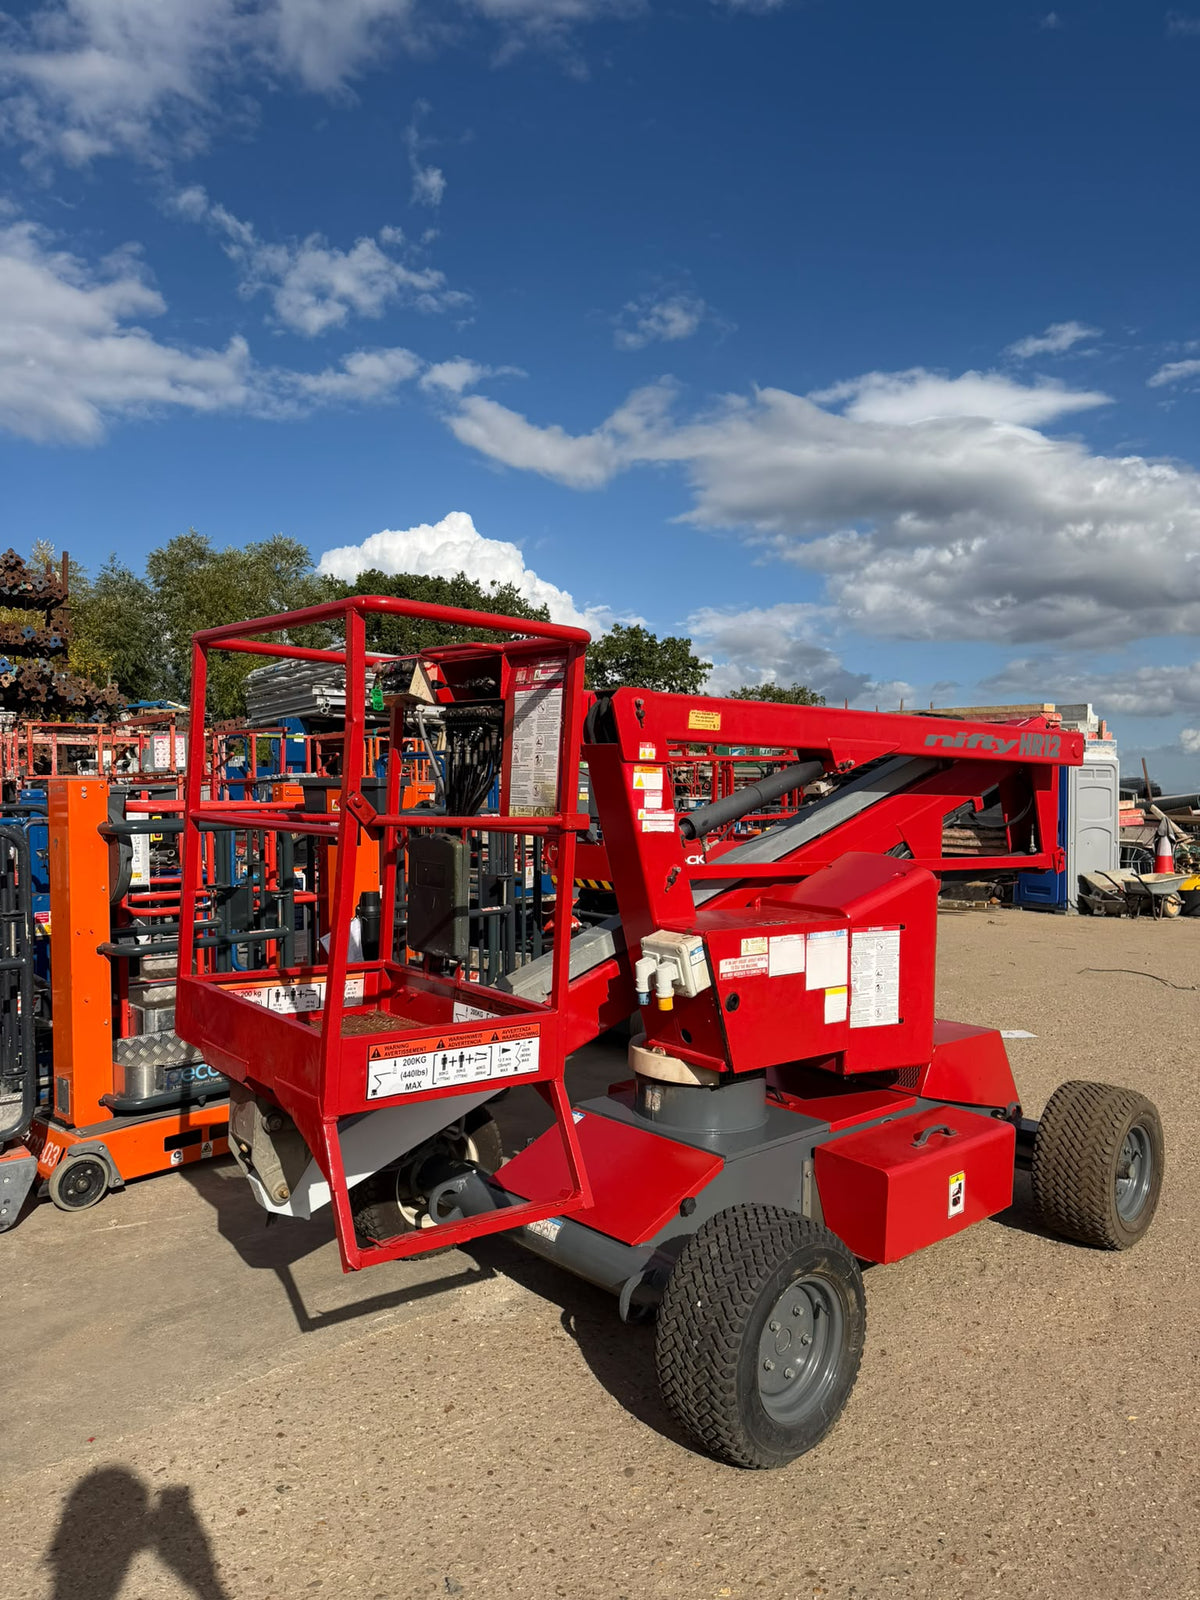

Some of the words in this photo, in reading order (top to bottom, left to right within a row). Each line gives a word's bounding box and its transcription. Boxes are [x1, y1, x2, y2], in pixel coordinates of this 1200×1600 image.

[924, 732, 1019, 754] nifty
[1018, 732, 1061, 758] HR12
[684, 854, 705, 865] CK
[240, 990, 253, 998] 200
[253, 989, 262, 998] kg
[384, 1043, 409, 1051] WARNING
[448, 1039, 482, 1048] ADVERTENCIA
[384, 1046, 427, 1057] AVERTISSEMENT
[402, 1056, 427, 1067] 200KG
[400, 1067, 429, 1081] (440lbs)
[405, 1080, 422, 1091] MAX
